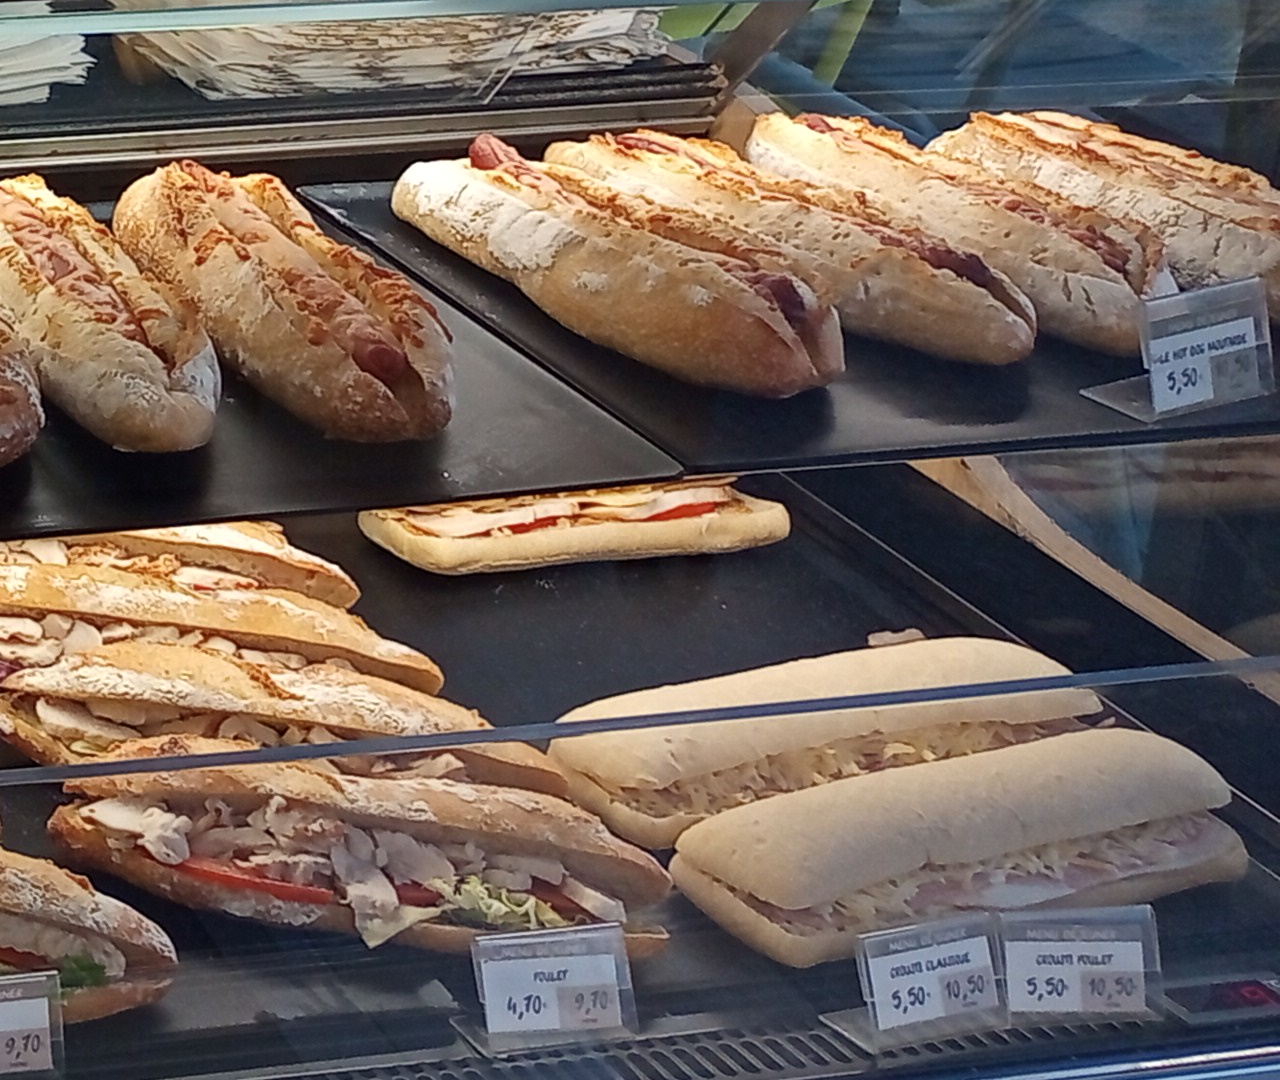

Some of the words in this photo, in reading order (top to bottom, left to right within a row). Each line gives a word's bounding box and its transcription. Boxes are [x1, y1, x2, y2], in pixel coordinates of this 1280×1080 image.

[1172, 347, 1188, 361] HOT
[1189, 343, 1205, 357] DOG
[1207, 333, 1247, 351] MOUTARDE
[1076, 953, 1114, 966] POULET
